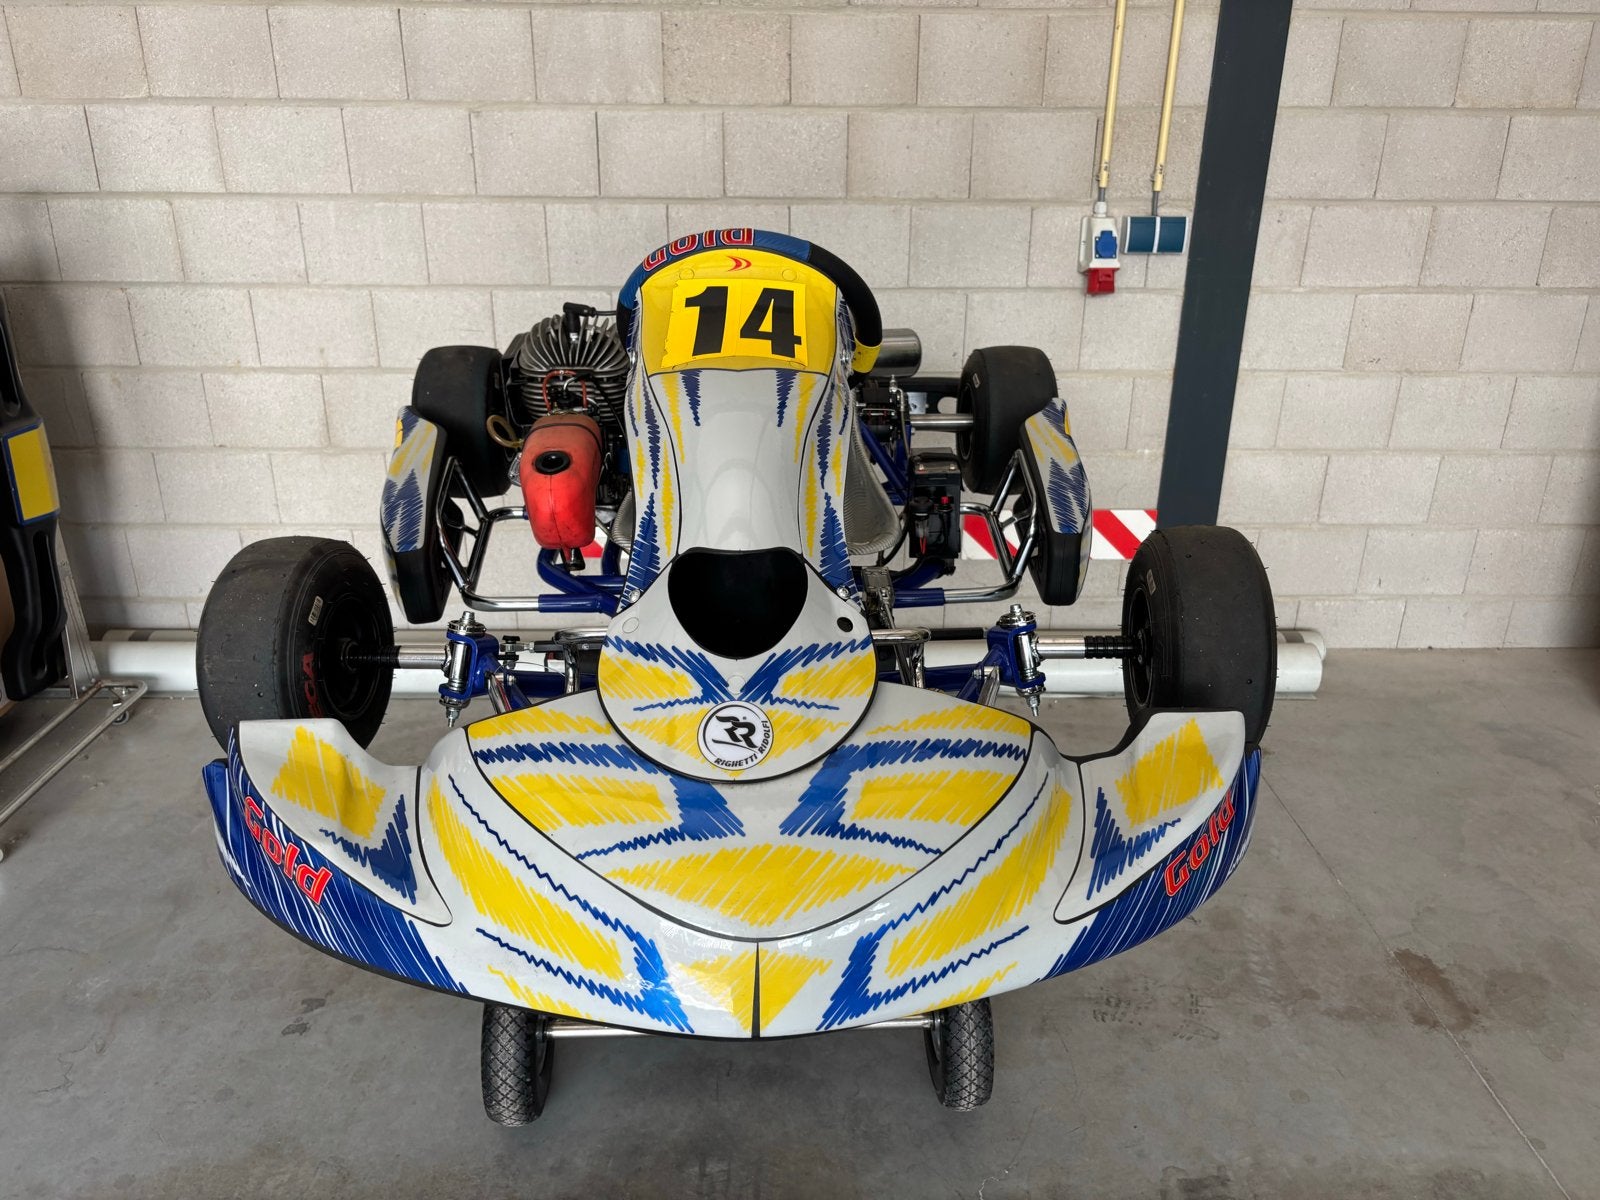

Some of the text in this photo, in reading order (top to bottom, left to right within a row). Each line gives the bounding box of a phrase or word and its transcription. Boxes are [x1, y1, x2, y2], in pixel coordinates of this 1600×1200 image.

[685, 286, 802, 359] 14
[714, 720, 771, 768] RIGHETTI RIDOLFI
[244, 796, 333, 905] Gold
[1164, 788, 1235, 897] Gold
